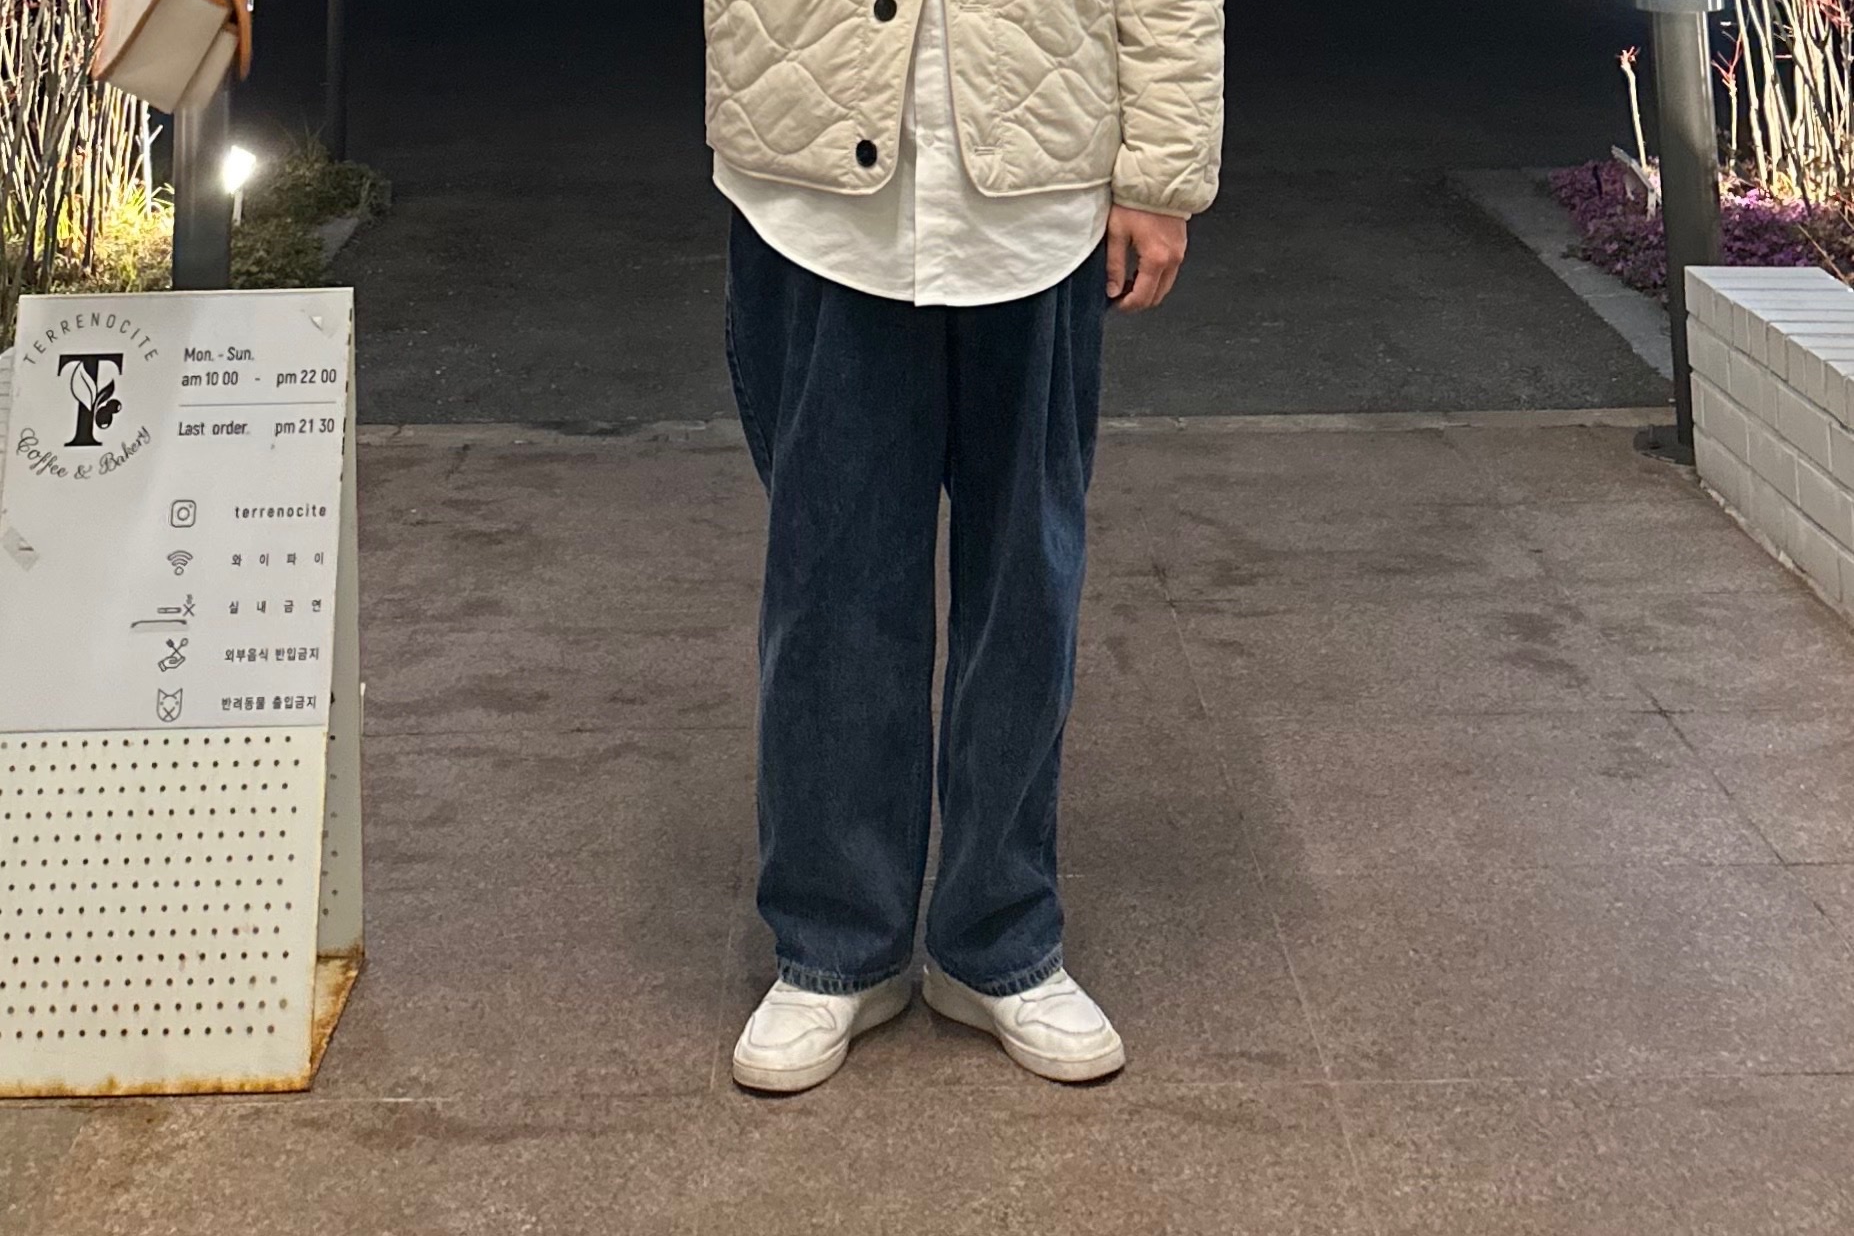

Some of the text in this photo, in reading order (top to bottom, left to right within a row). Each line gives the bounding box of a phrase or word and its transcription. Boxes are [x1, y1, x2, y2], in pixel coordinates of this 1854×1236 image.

[23, 312, 159, 365] TERRENOCITE
[184, 347, 214, 362] Mon.
[227, 346, 255, 361] Sun.
[181, 374, 201, 386] am
[276, 372, 297, 388] pm
[178, 421, 205, 436] Last
[275, 422, 295, 437] pm
[16, 425, 152, 480] Coffee & Bakery
[235, 503, 327, 518] terrenocite
[224, 647, 319, 662] 외부음식 반입금지
[221, 695, 316, 711] 반려동물 출입금지
